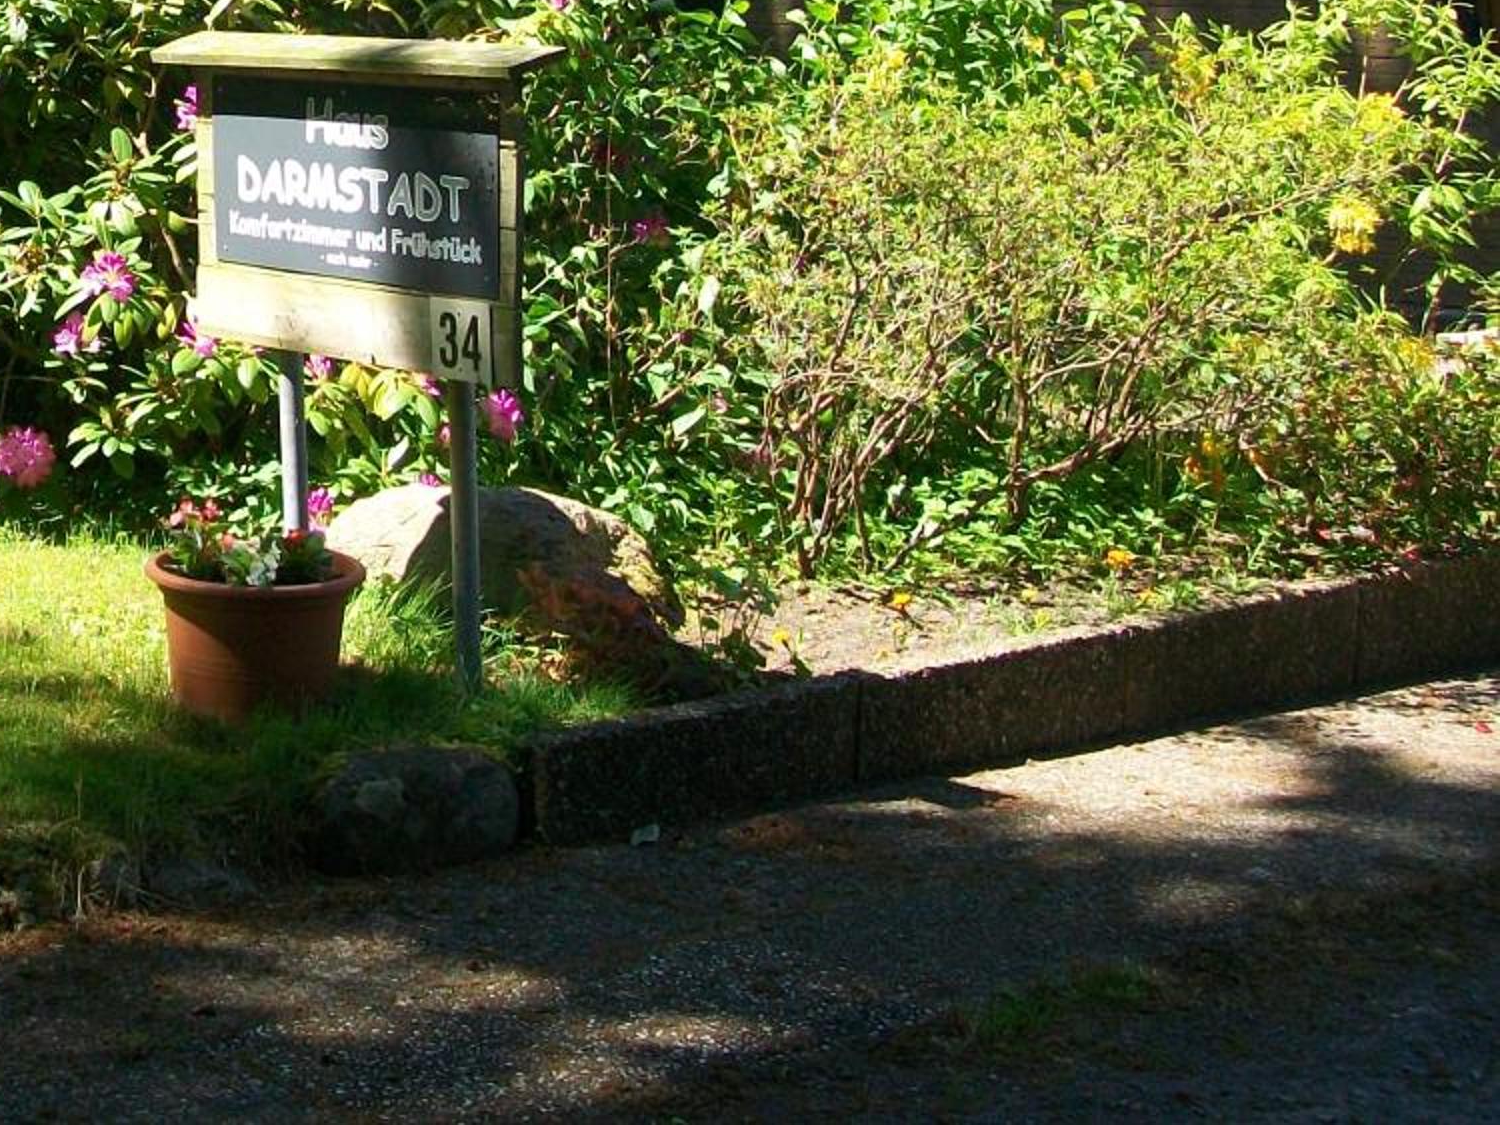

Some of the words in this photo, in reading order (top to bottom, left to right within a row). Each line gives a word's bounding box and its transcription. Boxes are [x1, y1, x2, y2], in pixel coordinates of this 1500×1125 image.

[305, 97, 389, 150] Haus
[237, 154, 470, 222] DARMSTADT
[355, 227, 388, 253] und
[391, 228, 483, 266] Frühstück
[439, 311, 481, 372] 34
